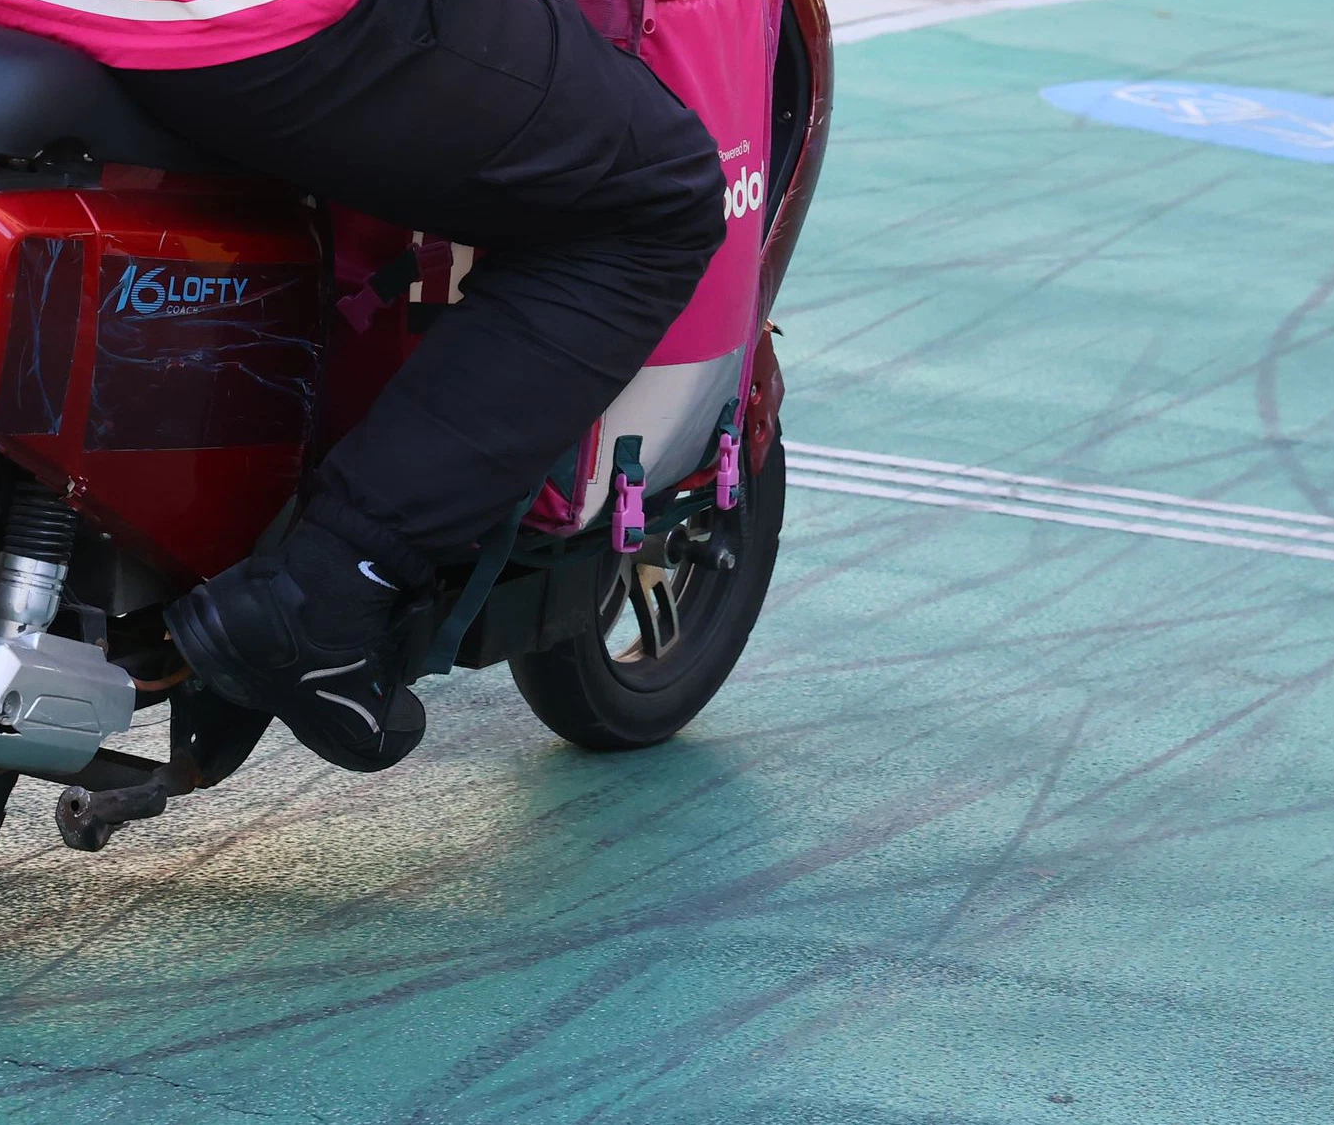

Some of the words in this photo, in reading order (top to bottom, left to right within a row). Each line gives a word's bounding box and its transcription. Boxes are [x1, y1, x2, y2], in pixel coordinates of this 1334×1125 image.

[718, 142, 743, 162] Powered
[742, 139, 750, 154] By
[116, 265, 166, 314] 16
[168, 276, 248, 303] LOFTY
